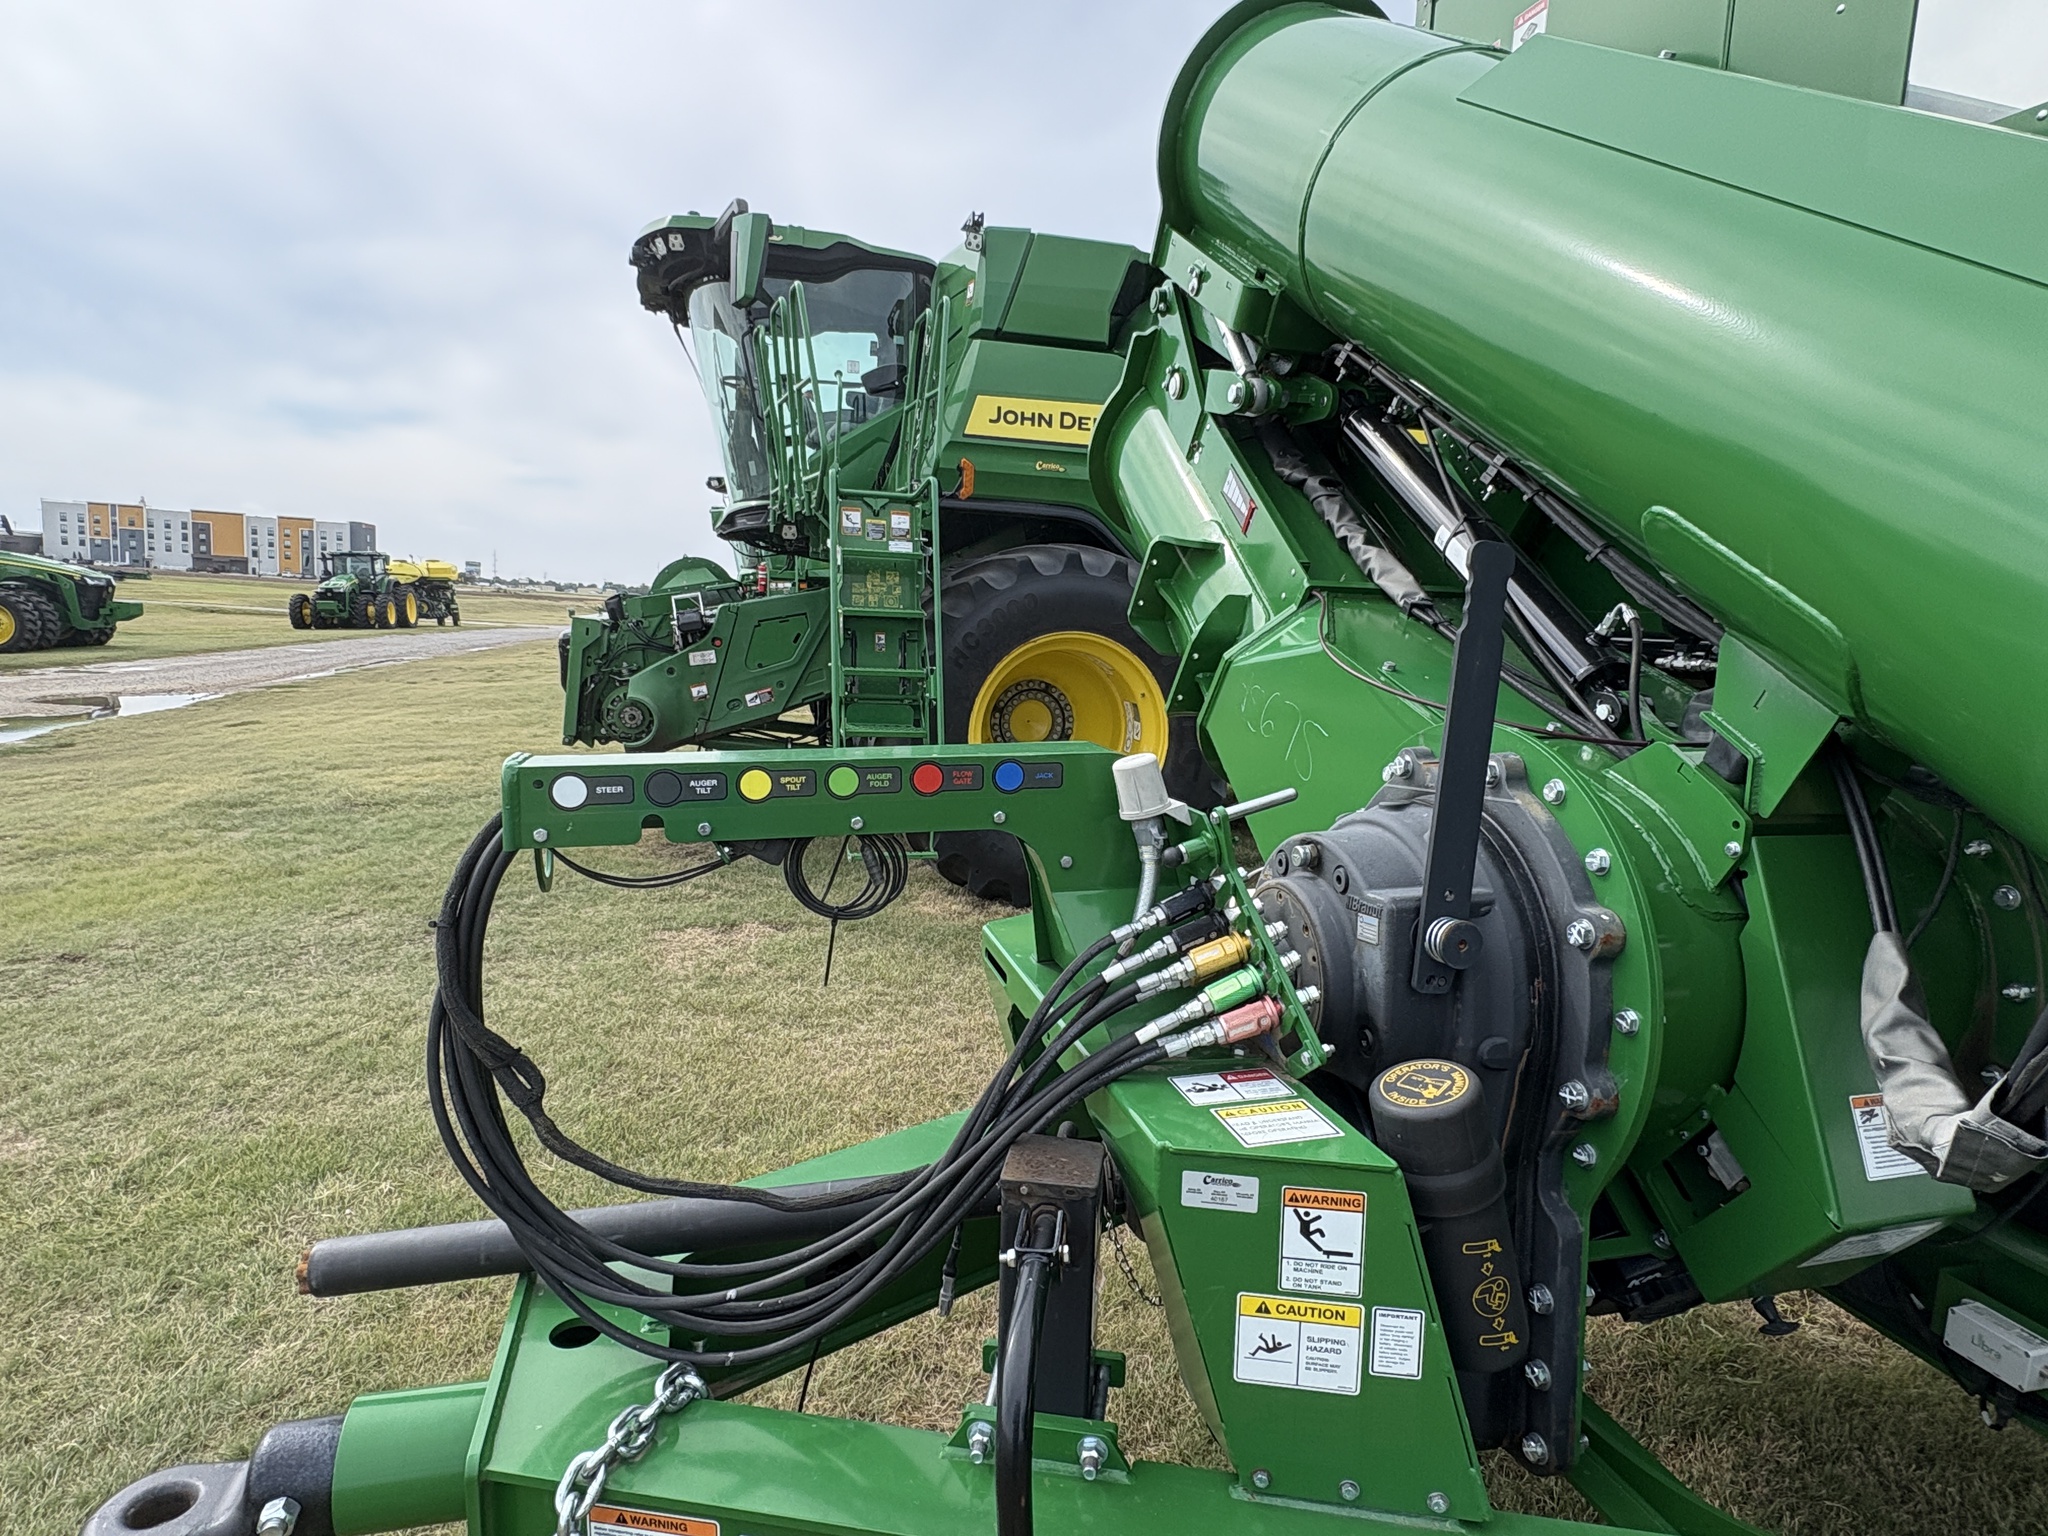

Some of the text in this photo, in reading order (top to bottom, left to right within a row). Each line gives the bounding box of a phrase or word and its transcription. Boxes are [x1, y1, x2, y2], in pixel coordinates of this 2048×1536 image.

[988, 405, 1097, 431] JOHN DE
[866, 773, 893, 781] AUGER
[952, 770, 974, 778] FLOW
[689, 779, 718, 787] AUGER
[780, 776, 807, 784] SPOUT
[869, 780, 890, 788] FOLD
[952, 777, 973, 785] GATE
[595, 785, 624, 794] STEER
[695, 787, 712, 795] TILT
[785, 783, 802, 791] TILT
[1385, 1063, 1451, 1083] OPERATOR'S
[1445, 1071, 1465, 1097] MANUAL
[1387, 1091, 1427, 1105] INSIDE
[1237, 1103, 1303, 1115] CAUTION
[1203, 1175, 1234, 1185] Carrico
[1299, 1193, 1362, 1208] WARNING
[1293, 1267, 1324, 1275] MACHINE
[1320, 1279, 1343, 1287] STAND
[1275, 1303, 1346, 1321] CAUTION
[1378, 1313, 1418, 1321] IMPORTANT
[1306, 1335, 1346, 1347] SLIPPING
[1306, 1345, 1342, 1355] HAZARD
[630, 1515, 688, 1532] WARNING
